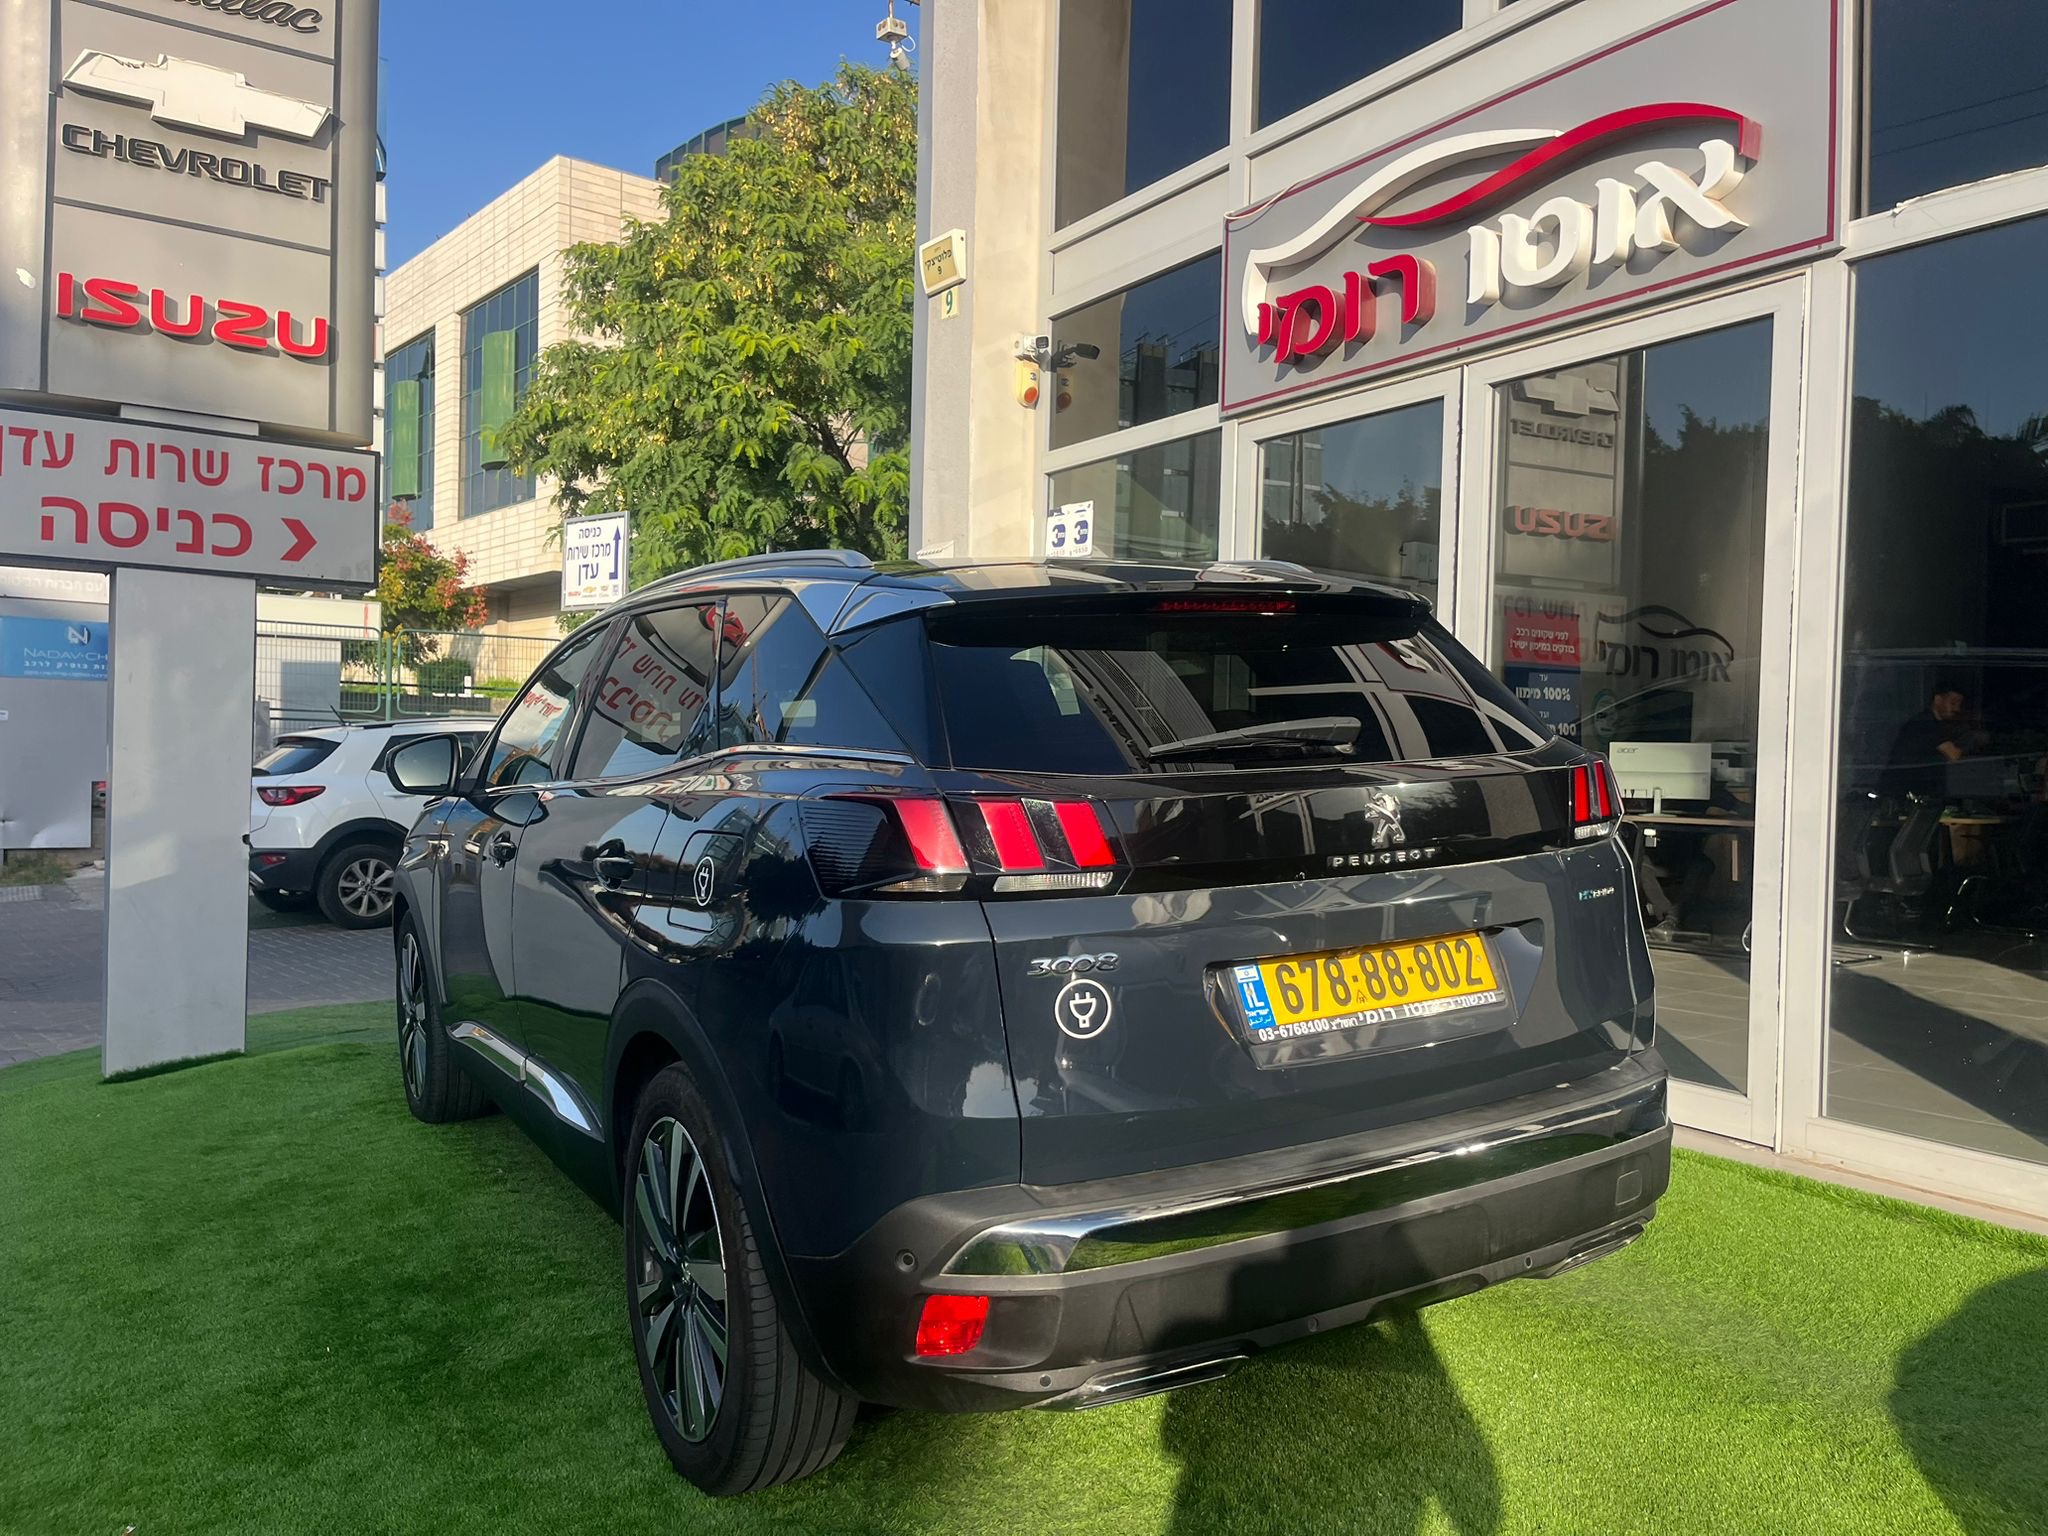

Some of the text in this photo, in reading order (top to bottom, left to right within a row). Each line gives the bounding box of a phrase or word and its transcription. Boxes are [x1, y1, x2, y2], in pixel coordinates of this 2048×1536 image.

[62, 123, 332, 203] CHEVROLET
[1257, 139, 1750, 364] אוטו רומי
[57, 272, 329, 358] ISUZU
[945, 290, 953, 315] 9
[104, 438, 230, 487] שרות
[257, 455, 367, 502] מרכז
[41, 496, 253, 557] כניסה
[578, 526, 602, 539] כניסה
[591, 542, 611, 559] מרכז
[578, 562, 599, 587] עדן
[1543, 686, 1571, 701] 100%
[1331, 848, 1436, 868] PEUGEOT
[1027, 952, 1119, 977] 3008
[1242, 982, 1265, 1008] IL
[1258, 1018, 1330, 1042] 03-6768100
